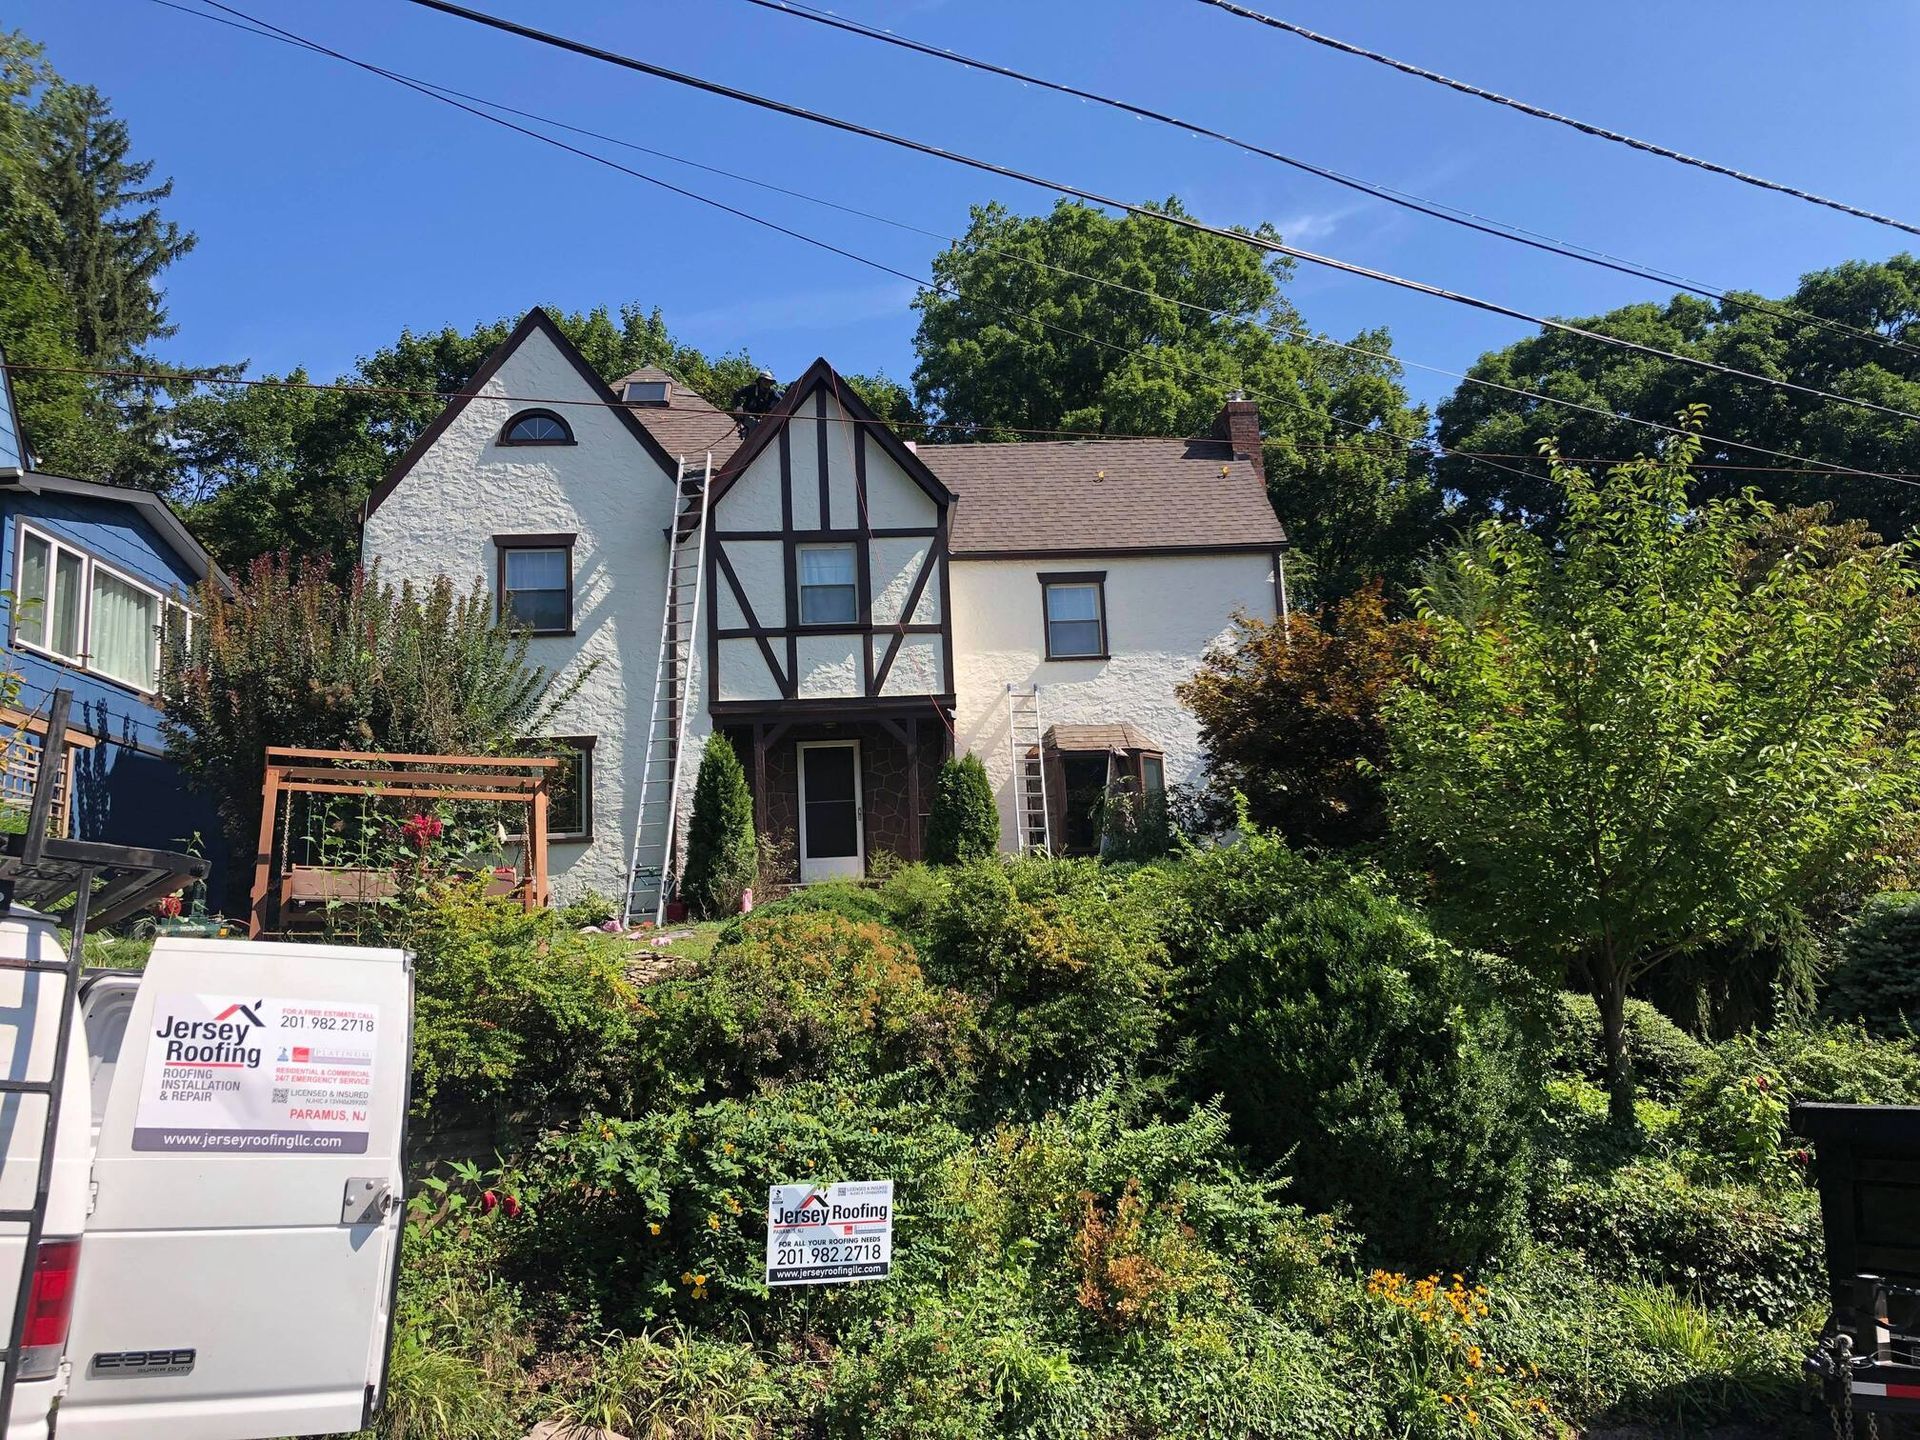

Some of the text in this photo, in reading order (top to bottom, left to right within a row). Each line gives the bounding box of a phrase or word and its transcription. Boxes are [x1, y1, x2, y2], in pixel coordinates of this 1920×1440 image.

[304, 1009, 322, 1017] FREE
[324, 1010, 356, 1019] ESTIMATE
[358, 1012, 375, 1020] CALL
[156, 1015, 250, 1046] Jersey
[280, 1015, 375, 1033] 201.982.2718
[166, 1040, 261, 1069] Roofing
[163, 1068, 213, 1079] ROOFING
[276, 1067, 319, 1076] RESIDENTIAL
[327, 1069, 370, 1078] COMMERCIAL
[161, 1079, 241, 1091] INSTALLATION
[291, 1075, 338, 1084] EMERGENCY
[339, 1077, 369, 1086] SERVICE
[159, 1090, 212, 1102] & REPAIR
[290, 1089, 328, 1098] LICENSED
[336, 1091, 369, 1099] INSURED
[290, 1108, 367, 1122] PARAMUS, NJ
[163, 1133, 342, 1149] www.jerseyroofingllc.com
[774, 1203, 888, 1226] Jersey Roofing
[829, 1237, 859, 1245] ROOFING
[777, 1244, 881, 1266] 201.982.2718
[777, 1265, 881, 1279] www.jerseyroofingllc.com
